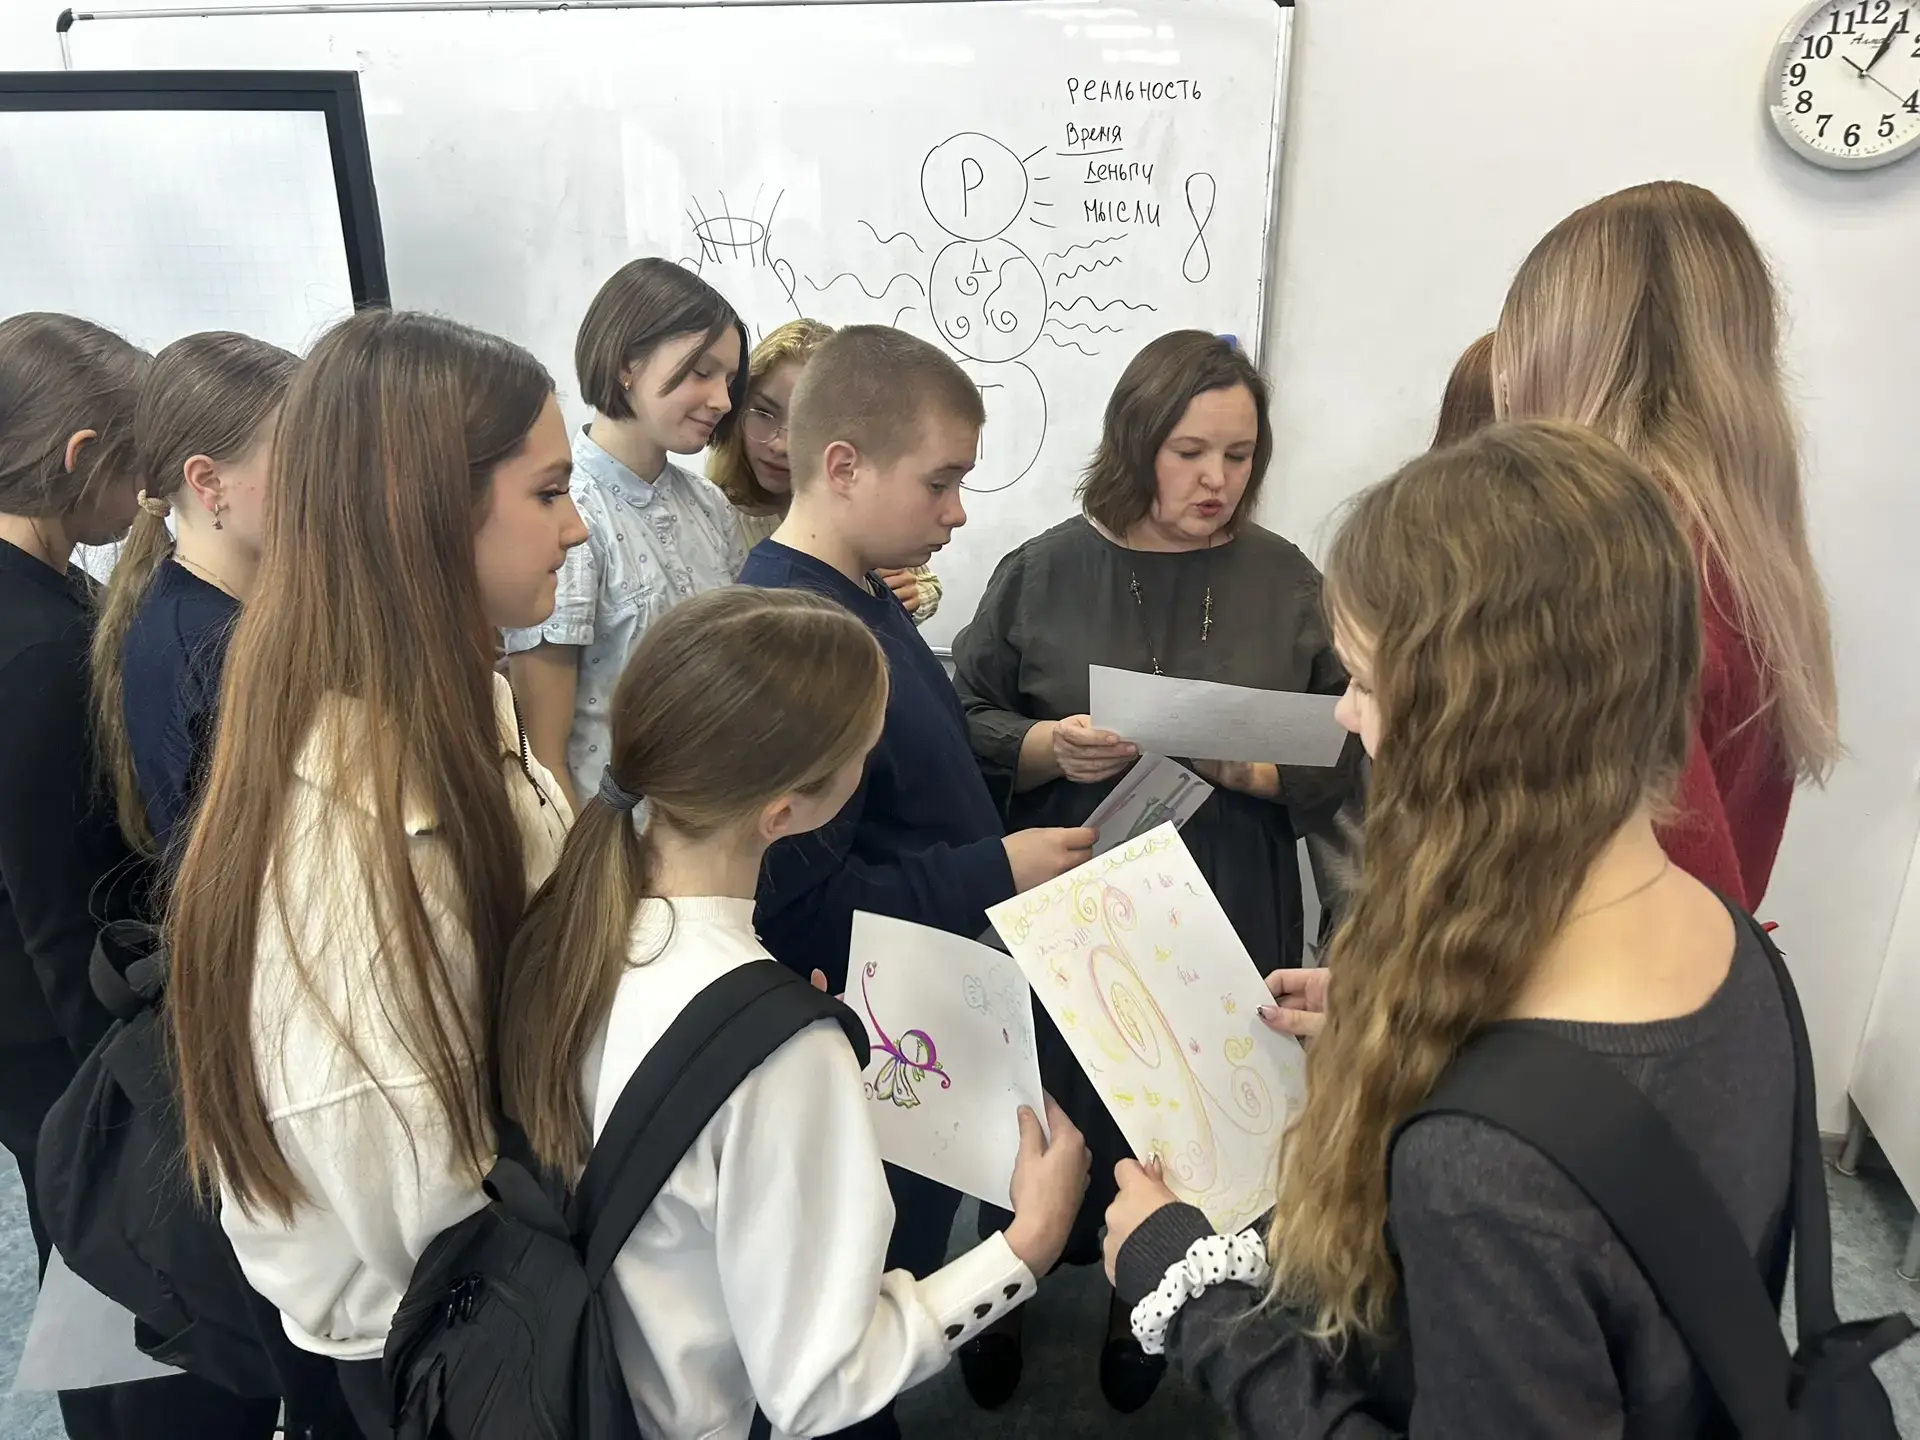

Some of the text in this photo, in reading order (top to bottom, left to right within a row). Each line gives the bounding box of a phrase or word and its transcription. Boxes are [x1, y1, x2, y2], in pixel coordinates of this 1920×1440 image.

[1826, 10, 1856, 35] 11
[1854, 0, 1891, 24] 12
[1896, 8, 1910, 34] 1
[1801, 35, 1833, 60] 10
[1789, 62, 1806, 87] 9
[1066, 77, 1202, 104] РЕАЛЬНОСТЬ
[1795, 90, 1813, 114] 8
[1902, 89, 1919, 114] 4
[1065, 121, 1124, 149] Время
[1816, 114, 1833, 138] 7
[1843, 123, 1861, 147] 6
[1877, 113, 1896, 138] 5
[1083, 198, 1161, 228] МЫСЛИ
